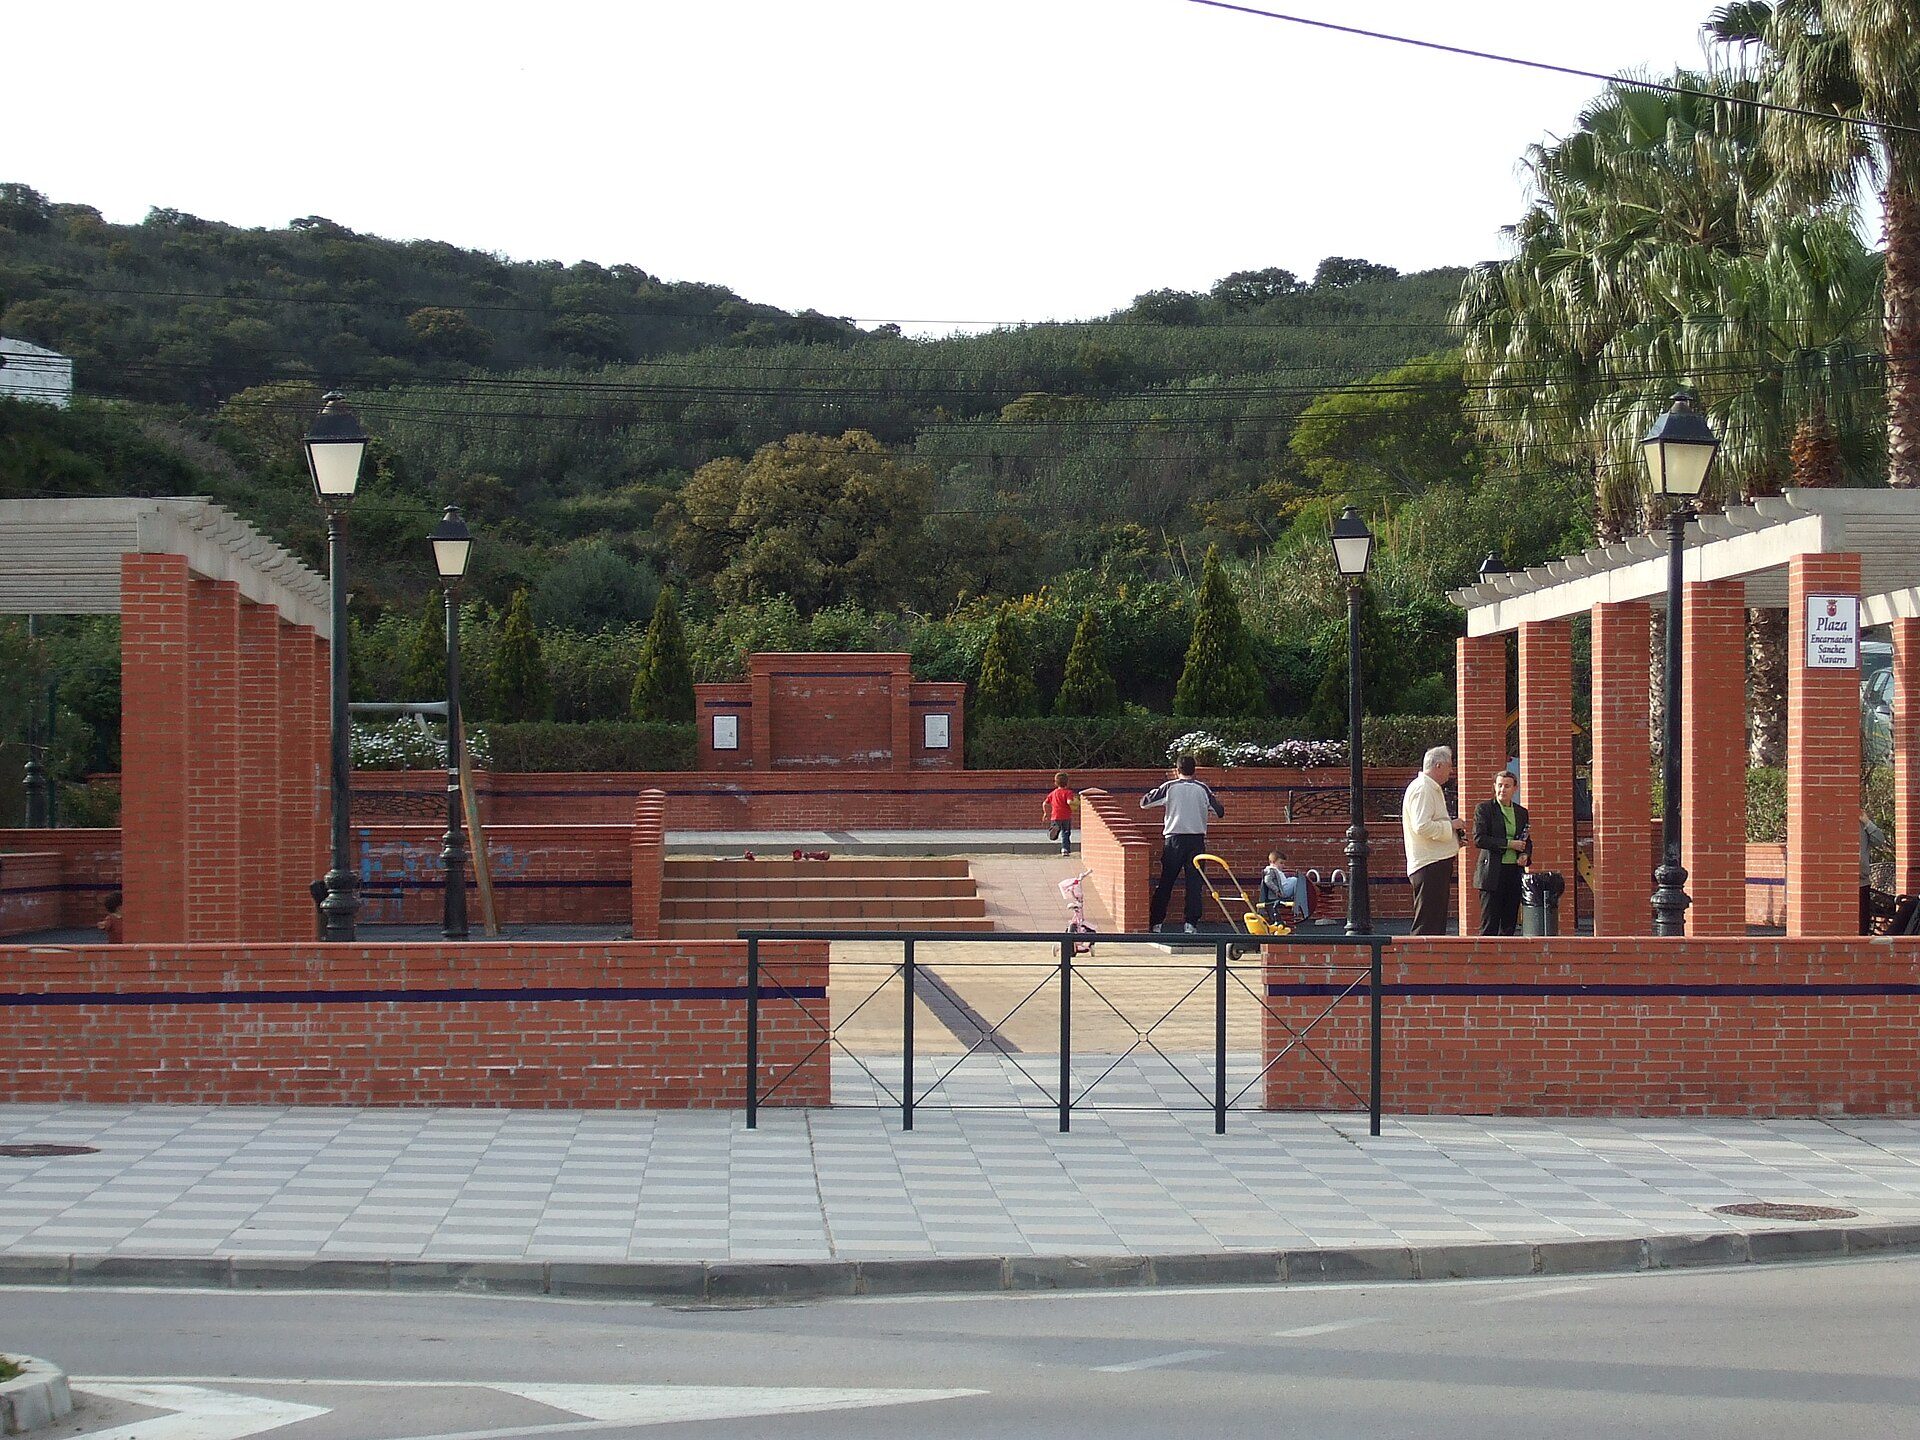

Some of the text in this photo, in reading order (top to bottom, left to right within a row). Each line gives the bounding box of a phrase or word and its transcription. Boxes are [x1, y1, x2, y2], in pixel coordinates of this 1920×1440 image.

[1816, 617, 1848, 631] Plaza
[1810, 633, 1853, 644] Encarnación
[1817, 644, 1846, 654] Sanchez
[1818, 654, 1848, 664] Navarro
